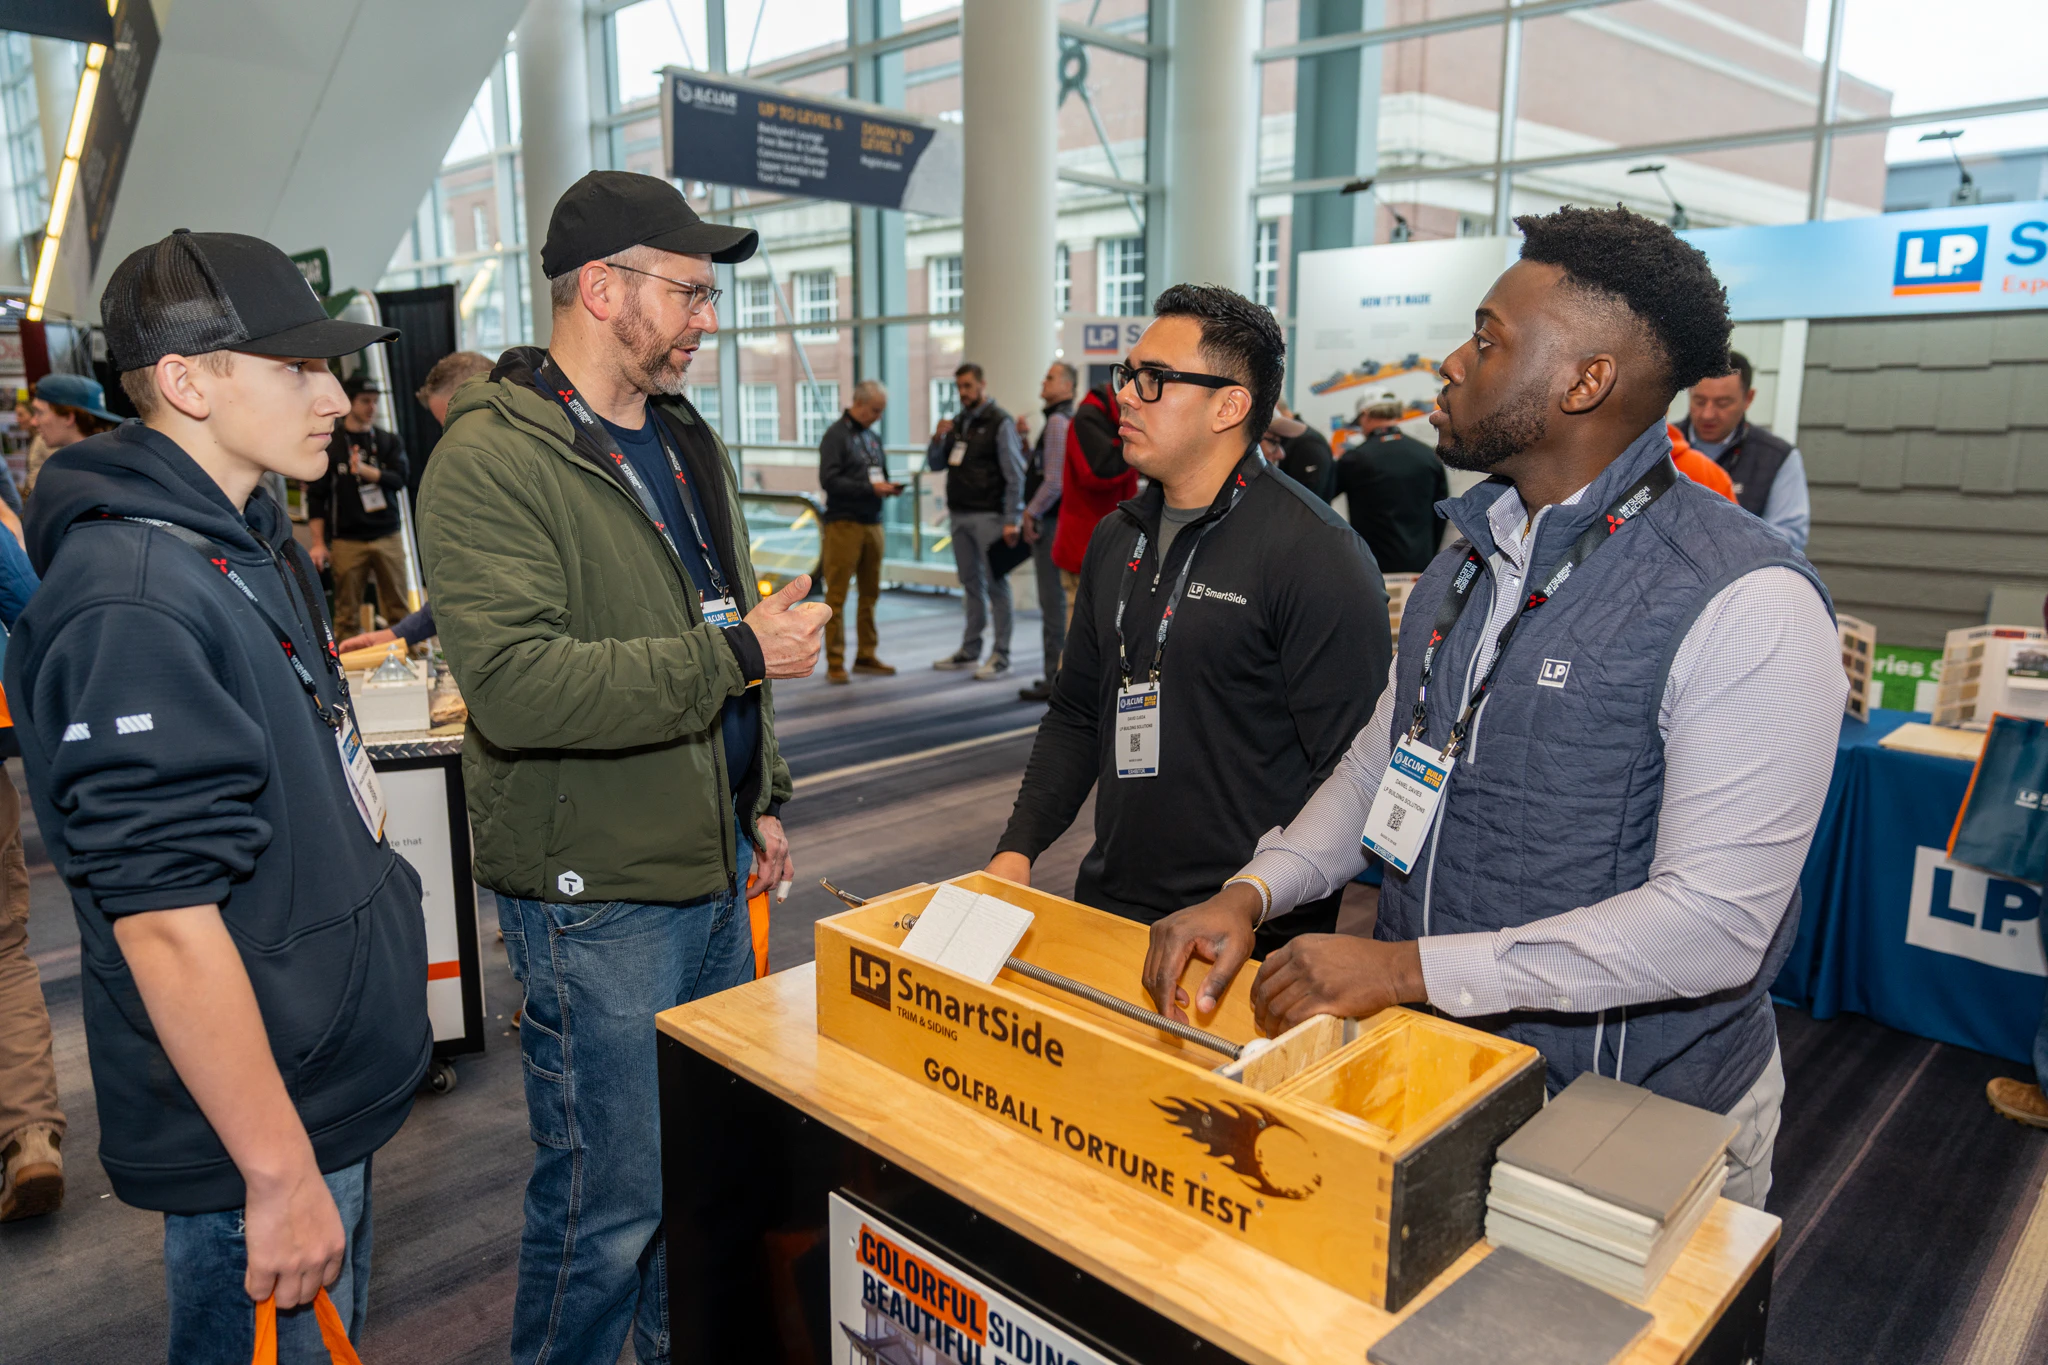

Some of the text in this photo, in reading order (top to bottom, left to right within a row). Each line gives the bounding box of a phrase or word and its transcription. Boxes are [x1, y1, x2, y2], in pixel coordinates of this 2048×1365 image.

[758, 101, 777, 118] UP
[779, 104, 796, 122] TO
[797, 108, 831, 129] LEVEL
[861, 138, 893, 153] LEVEL
[862, 121, 915, 145] DOWN TO
[1904, 234, 1979, 279] LP
[1360, 296, 1381, 308] HOW
[1404, 292, 1432, 305] MADE
[1087, 328, 1116, 347] LP
[568, 402, 587, 423] ELECTRIC
[1619, 486, 1651, 515] MITSUBISHI
[1624, 494, 1652, 519] ELECTRIC
[1453, 561, 1471, 588] ELECTRIC
[1457, 564, 1478, 595] MITSUBISHI
[1544, 562, 1572, 593] MITSUBISHI
[1191, 585, 1247, 605] LP SmartSide
[1543, 662, 1566, 679] LP
[1423, 774, 1440, 788] BETTER
[1426, 768, 1443, 781] BUILD
[1395, 779, 1422, 797] DANIEL DAVIES
[1388, 789, 1405, 802] BUILDING
[1404, 798, 1426, 814] SOLUTIONS
[403, 837, 422, 846] that
[1930, 866, 2041, 934] LP
[854, 956, 1064, 1068] LP SmartSide
[897, 1006, 958, 1042] TRIM & SIDING
[924, 1057, 1252, 1232] GOLFBALL TORTURE TEST
[862, 1231, 1081, 1365] COLORFUL SIDIN
